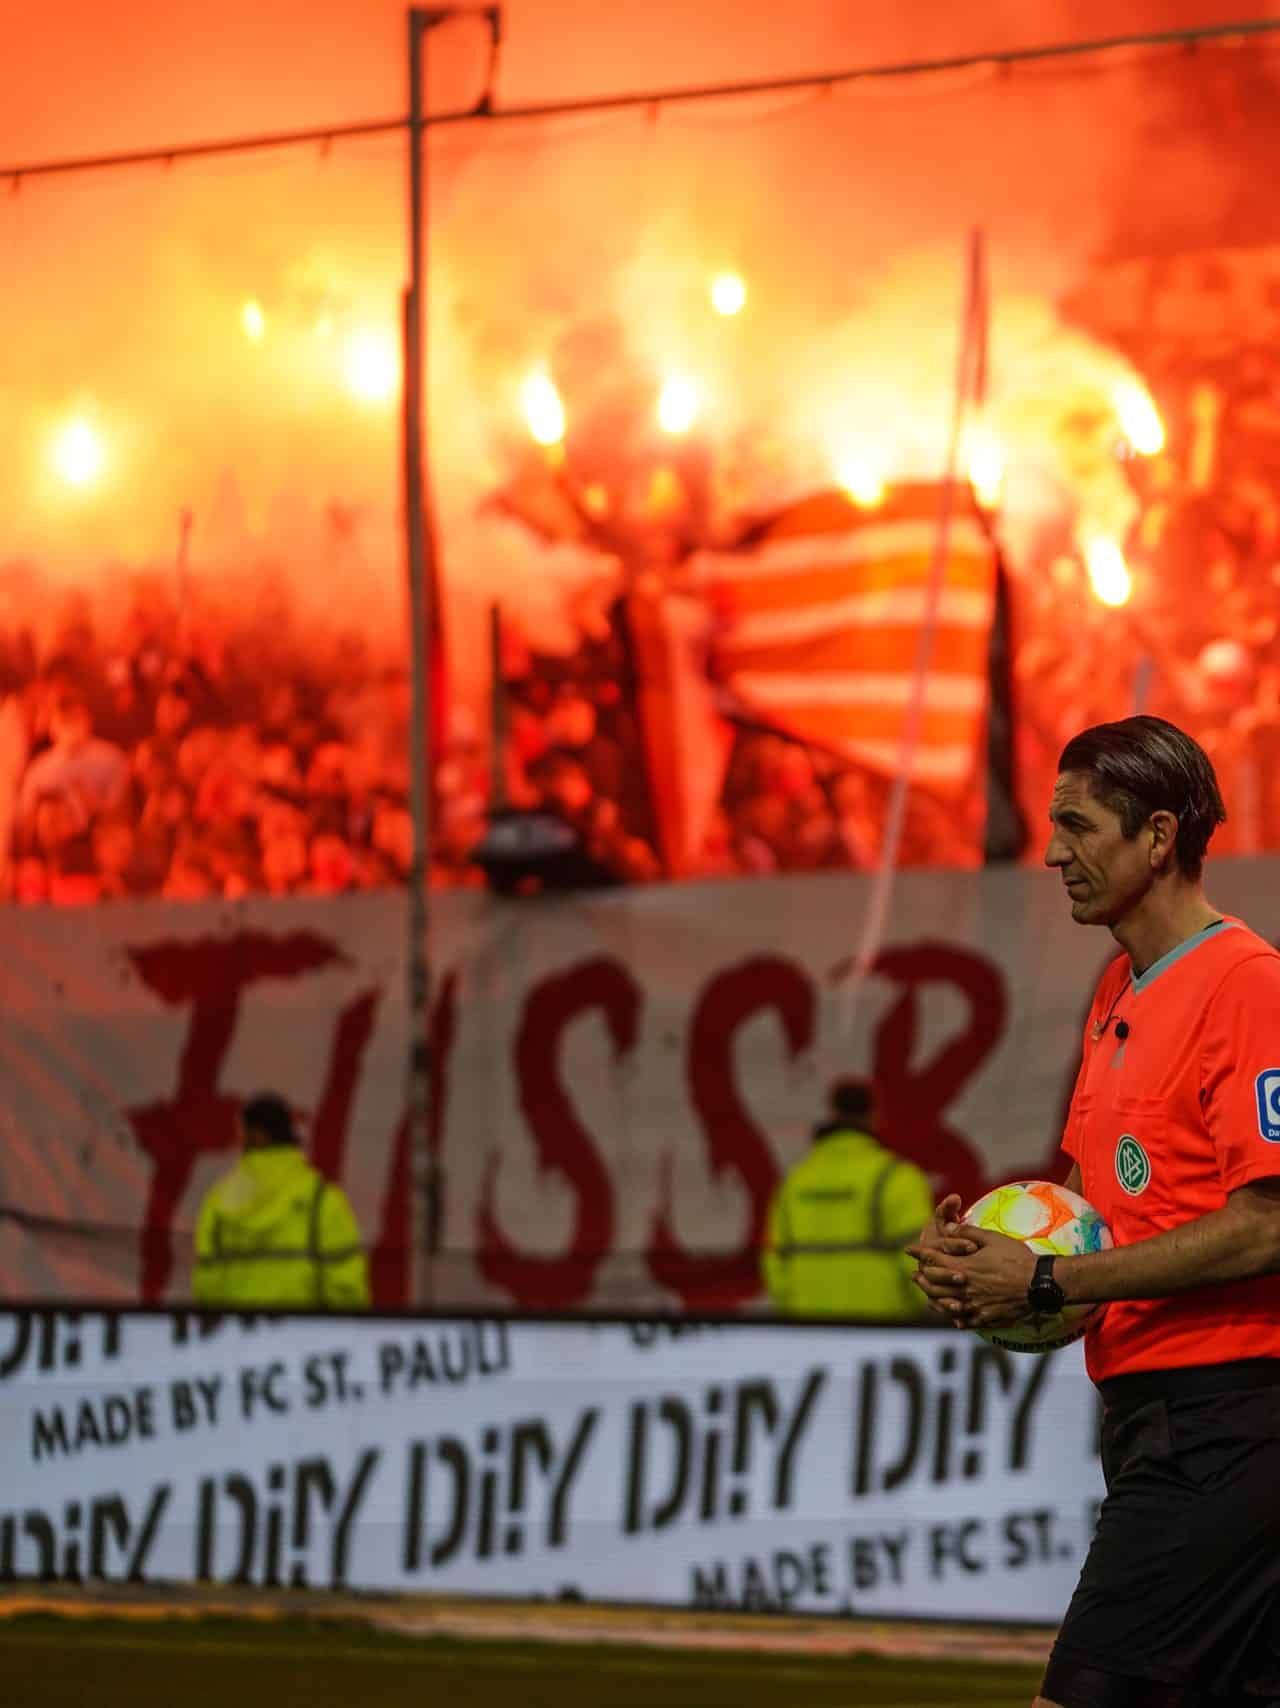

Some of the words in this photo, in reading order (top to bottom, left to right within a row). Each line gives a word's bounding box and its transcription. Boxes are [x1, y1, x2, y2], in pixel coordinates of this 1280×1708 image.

[31, 1388, 154, 1462] MADE
[172, 1374, 222, 1431] BY
[241, 1363, 288, 1420] FC
[379, 1321, 511, 1393] PAULI
[850, 1533, 908, 1591] BY
[929, 1517, 985, 1579] FC
